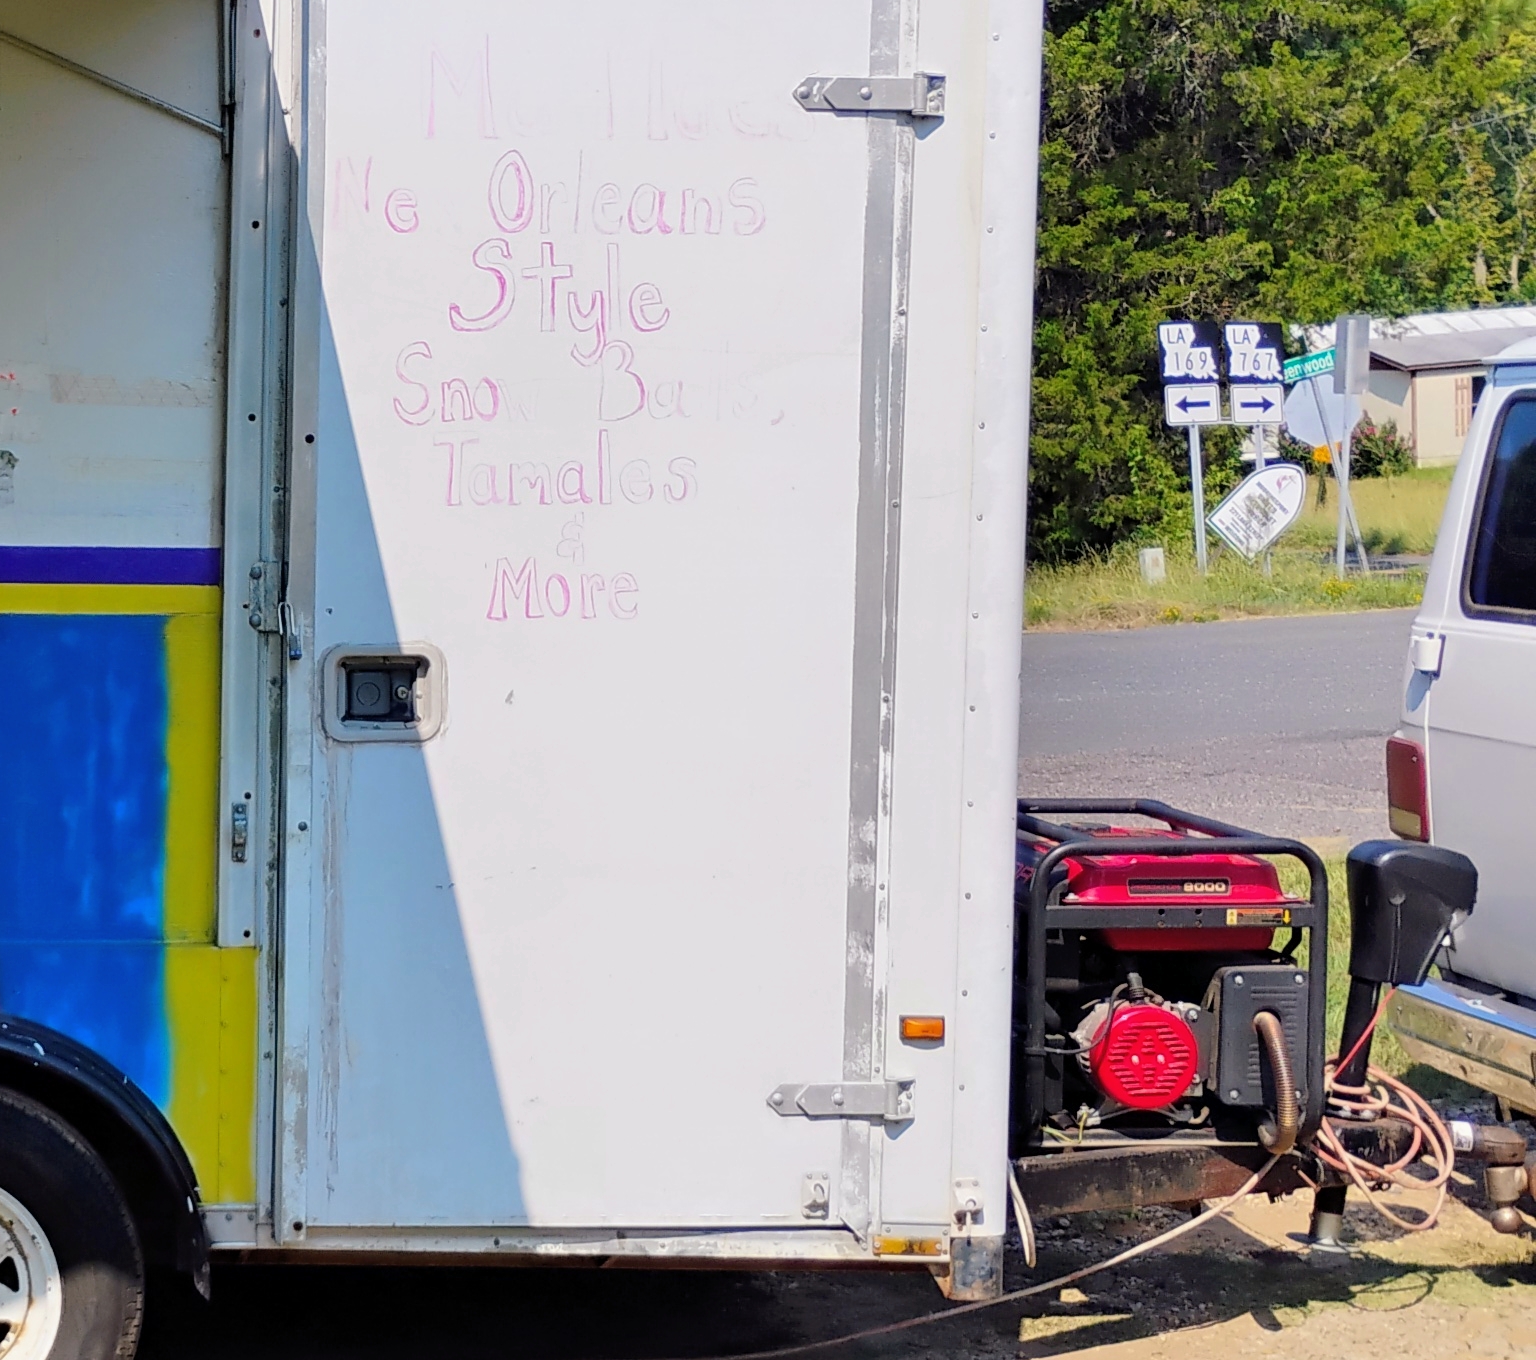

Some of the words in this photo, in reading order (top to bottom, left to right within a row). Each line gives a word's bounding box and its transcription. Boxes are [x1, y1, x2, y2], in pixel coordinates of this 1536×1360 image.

[486, 147, 768, 237] Orleans
[448, 238, 670, 367] Style
[1166, 328, 1186, 344] LA
[1232, 328, 1250, 344] LA
[1173, 351, 1208, 371] 169
[1239, 352, 1274, 372] 767
[432, 428, 699, 507] Tamales
[485, 556, 641, 622] More
